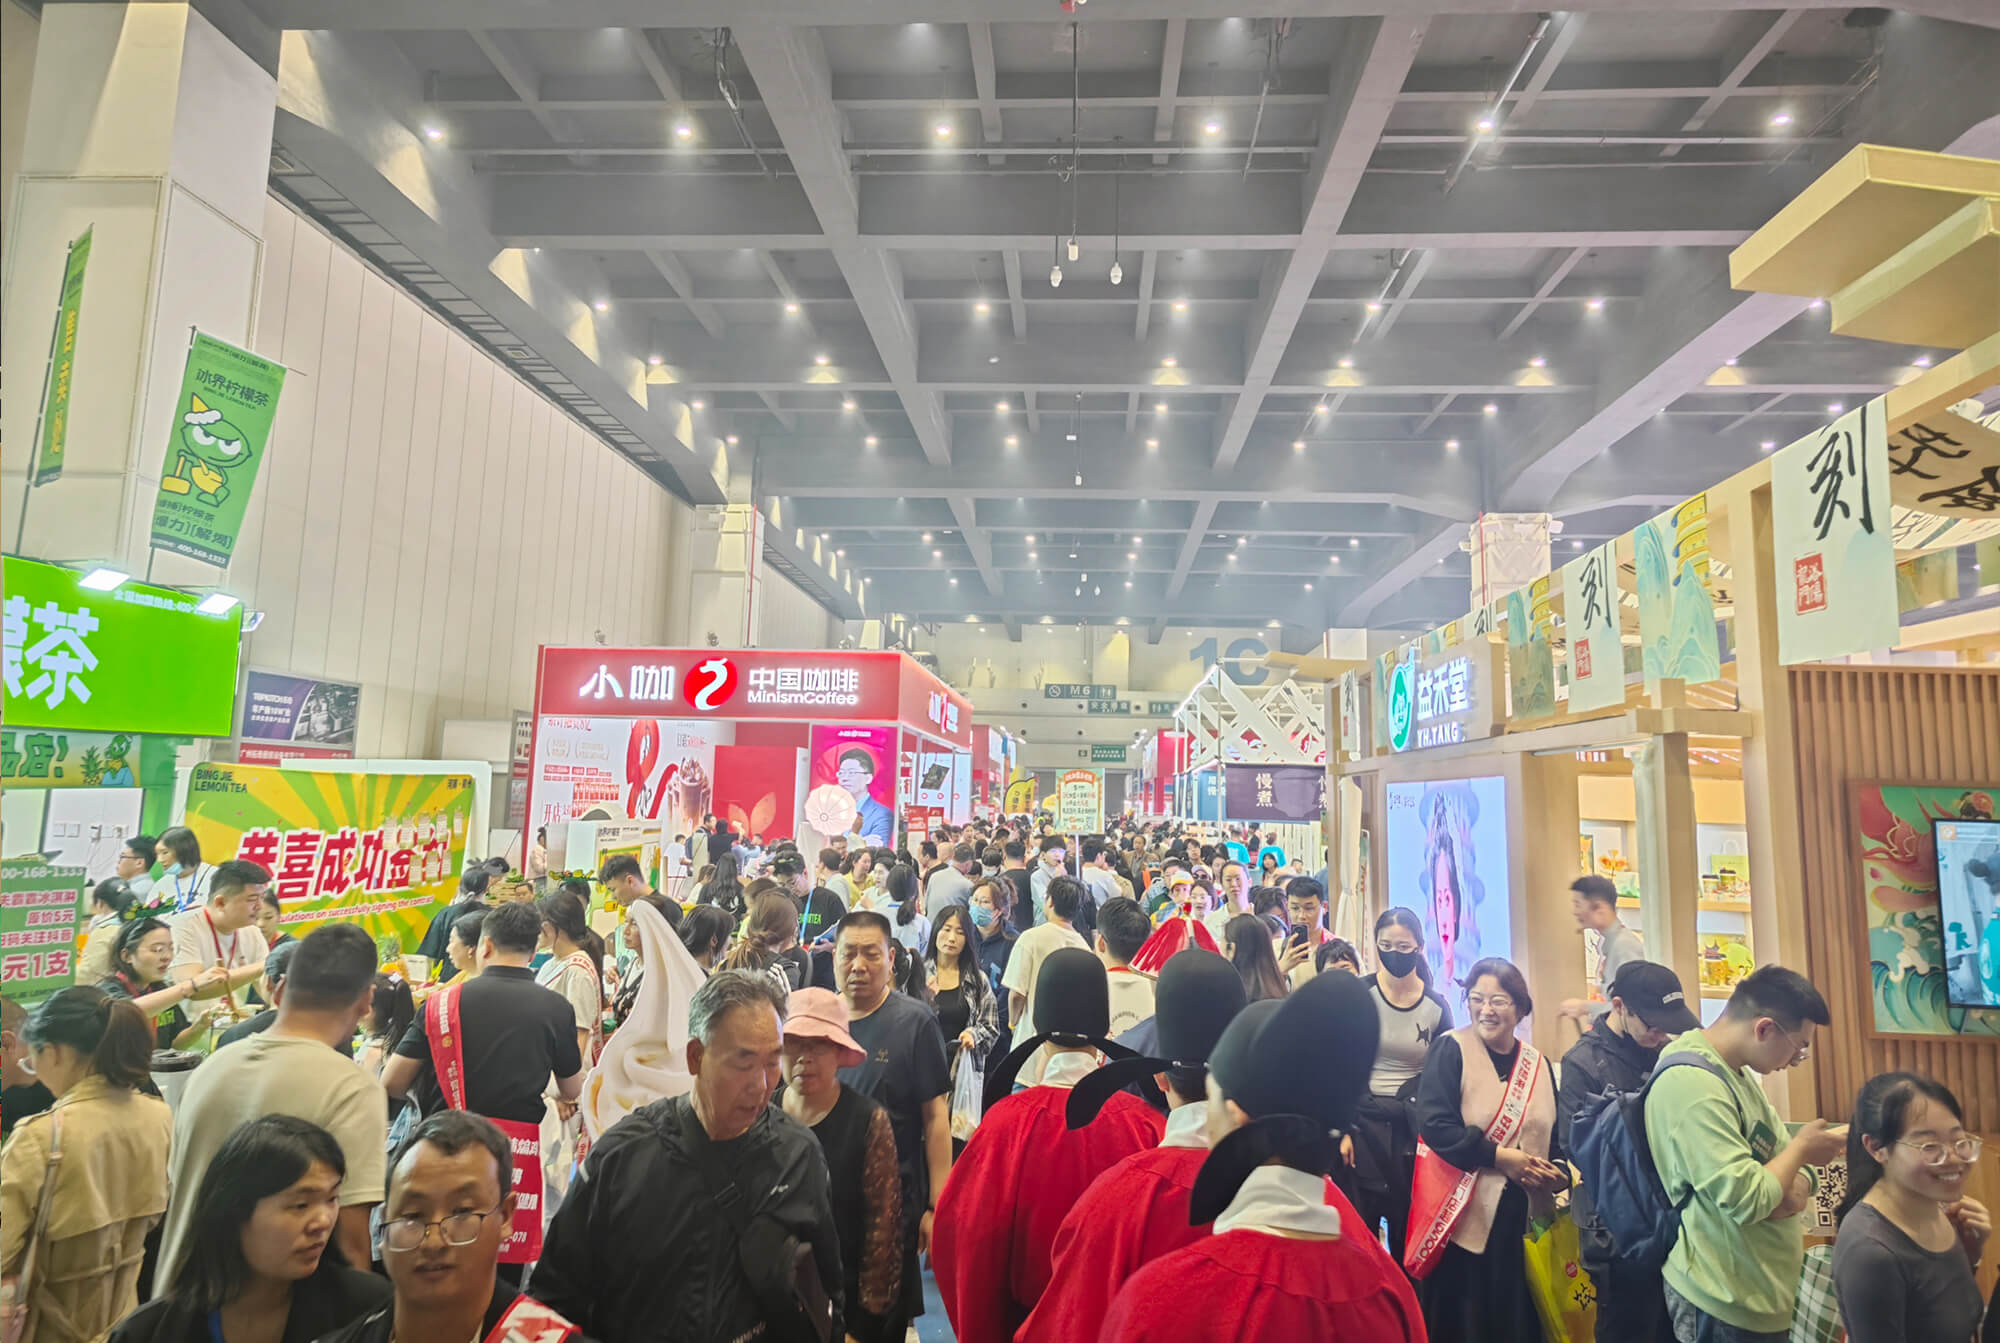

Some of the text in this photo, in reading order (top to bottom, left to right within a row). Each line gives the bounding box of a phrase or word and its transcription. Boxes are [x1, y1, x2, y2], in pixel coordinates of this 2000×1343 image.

[579, 664, 860, 700] 小咖 中国咖啡
[1416, 656, 1467, 721] 益禾堂
[747, 690, 859, 706] MinismCoffee
[196, 769, 233, 781] BING JIE
[194, 781, 248, 793] LEMON TEA
